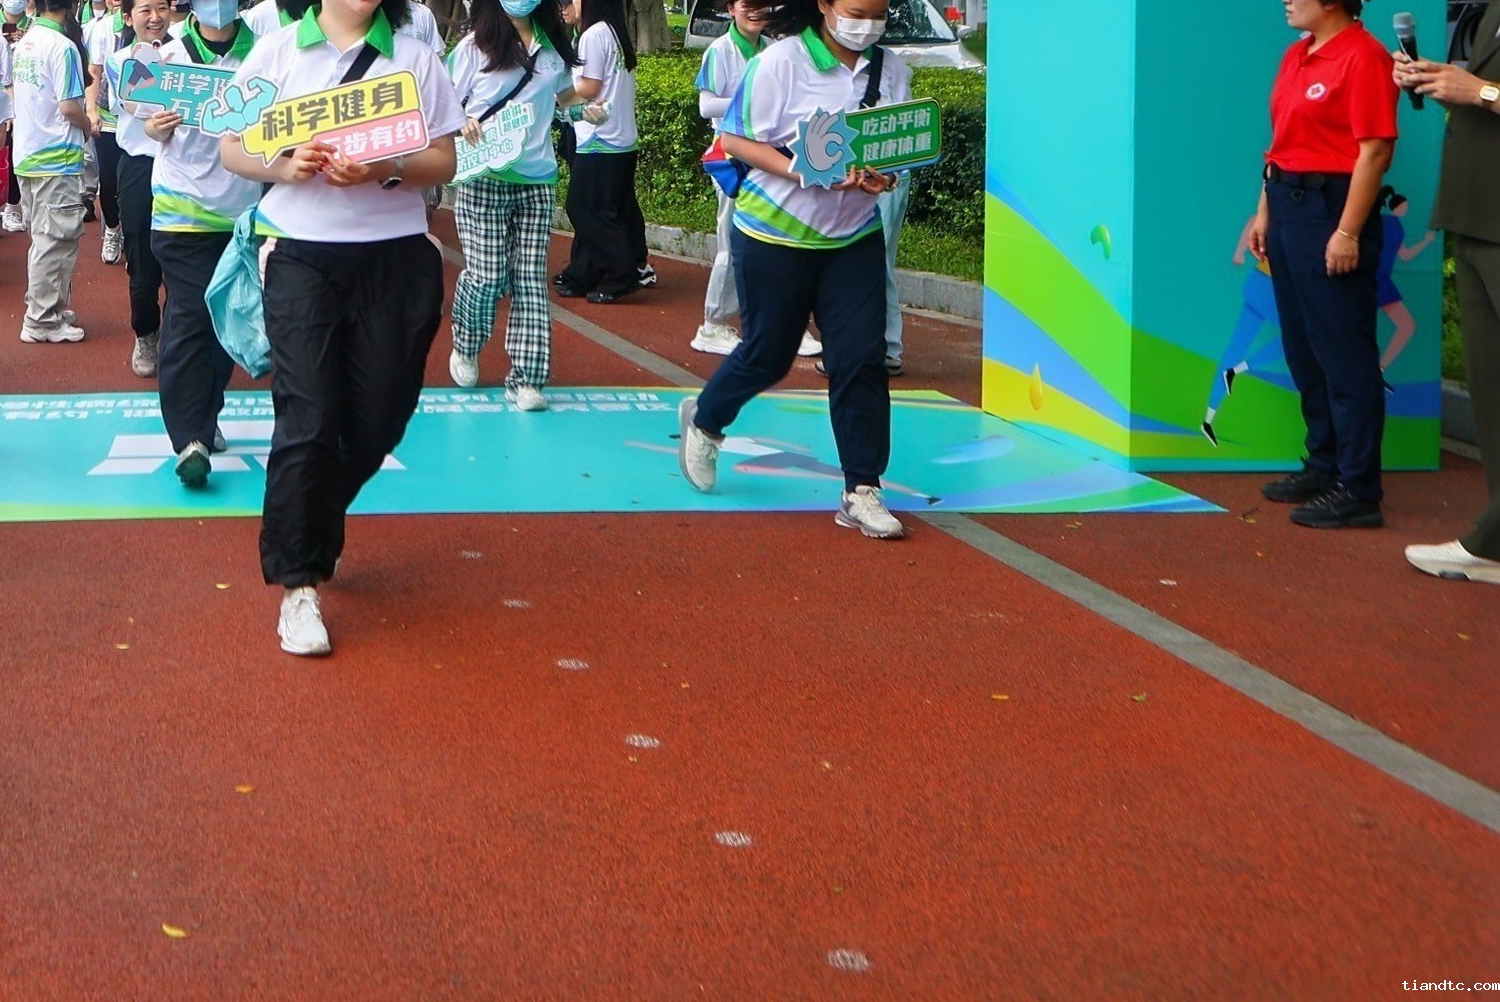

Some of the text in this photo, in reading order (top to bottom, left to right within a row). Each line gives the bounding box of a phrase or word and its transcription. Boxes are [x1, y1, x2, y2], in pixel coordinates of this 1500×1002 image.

[262, 81, 403, 141] 科学健身
[862, 108, 931, 136] 吃动平衡
[863, 132, 932, 162] 健康体重
